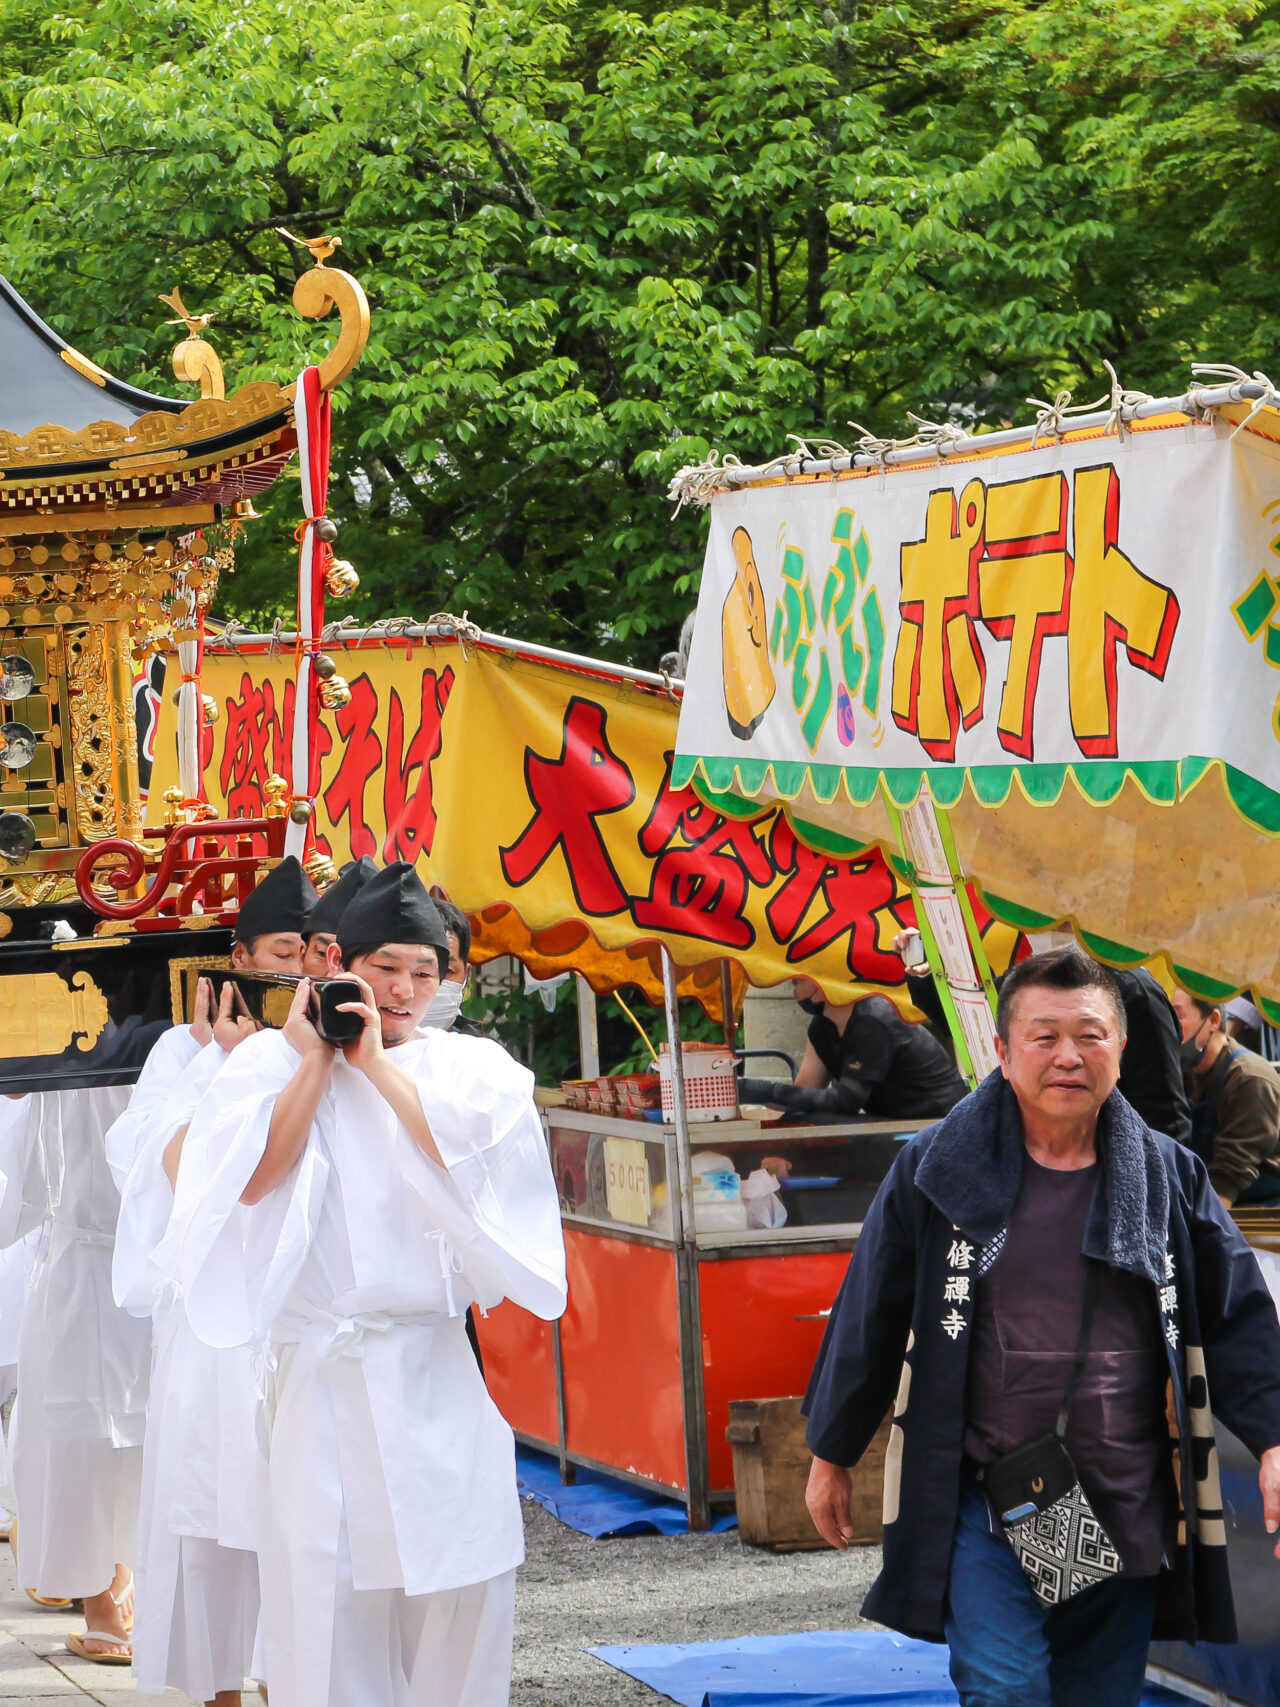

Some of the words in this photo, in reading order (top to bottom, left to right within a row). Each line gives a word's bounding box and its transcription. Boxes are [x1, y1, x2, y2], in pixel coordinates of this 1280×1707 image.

[892, 462, 1181, 763] ポテト
[176, 664, 455, 866] 盛そば
[610, 1162, 646, 1195] 500円
